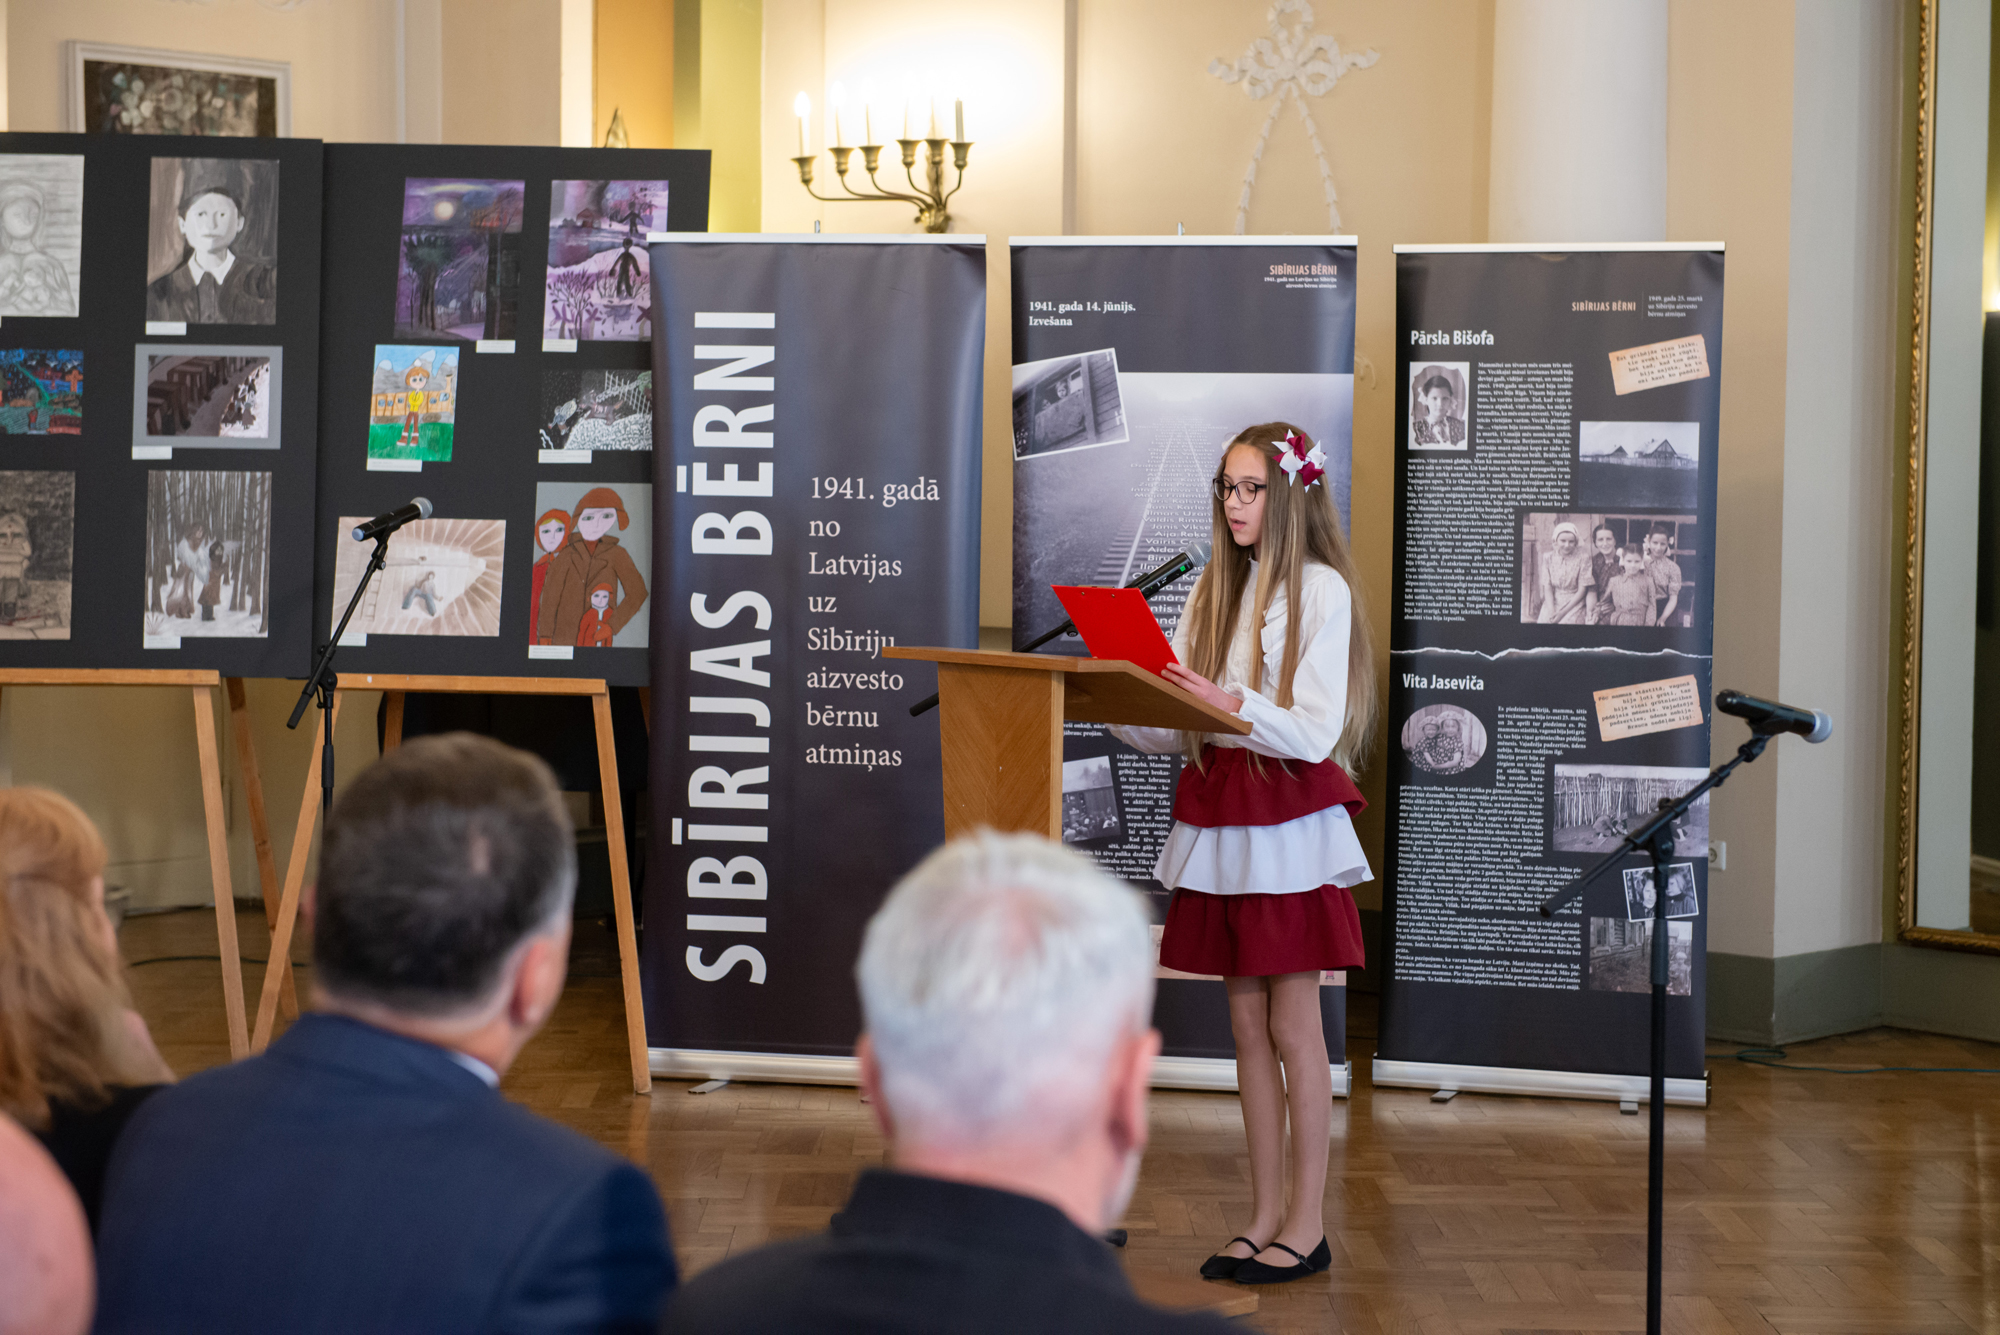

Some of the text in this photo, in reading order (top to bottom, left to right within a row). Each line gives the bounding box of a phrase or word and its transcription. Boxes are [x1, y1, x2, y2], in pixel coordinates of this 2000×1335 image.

[1269, 263, 1337, 275] SIBĪRIJAS BĒRNI
[1029, 301, 1136, 314] 1941. gada 14. jūnijs.
[1572, 300, 1636, 312] SIBĪRIJAS BĒRNI
[1029, 316, 1073, 326] Izvešana
[1410, 329, 1494, 346] Pārsla Bišofa
[811, 476, 940, 507] 1941. gadā
[808, 516, 841, 537] no
[808, 552, 902, 583] Latvijas
[808, 594, 837, 613] uz
[671, 312, 776, 984] SIBĪRIJAS BĒRNI
[807, 628, 896, 659] Sibīriju
[806, 668, 904, 691] aizvesto
[1403, 673, 1484, 690] Vita Jaseviča
[806, 702, 879, 728] bērnu
[805, 743, 903, 771] atmiņas
